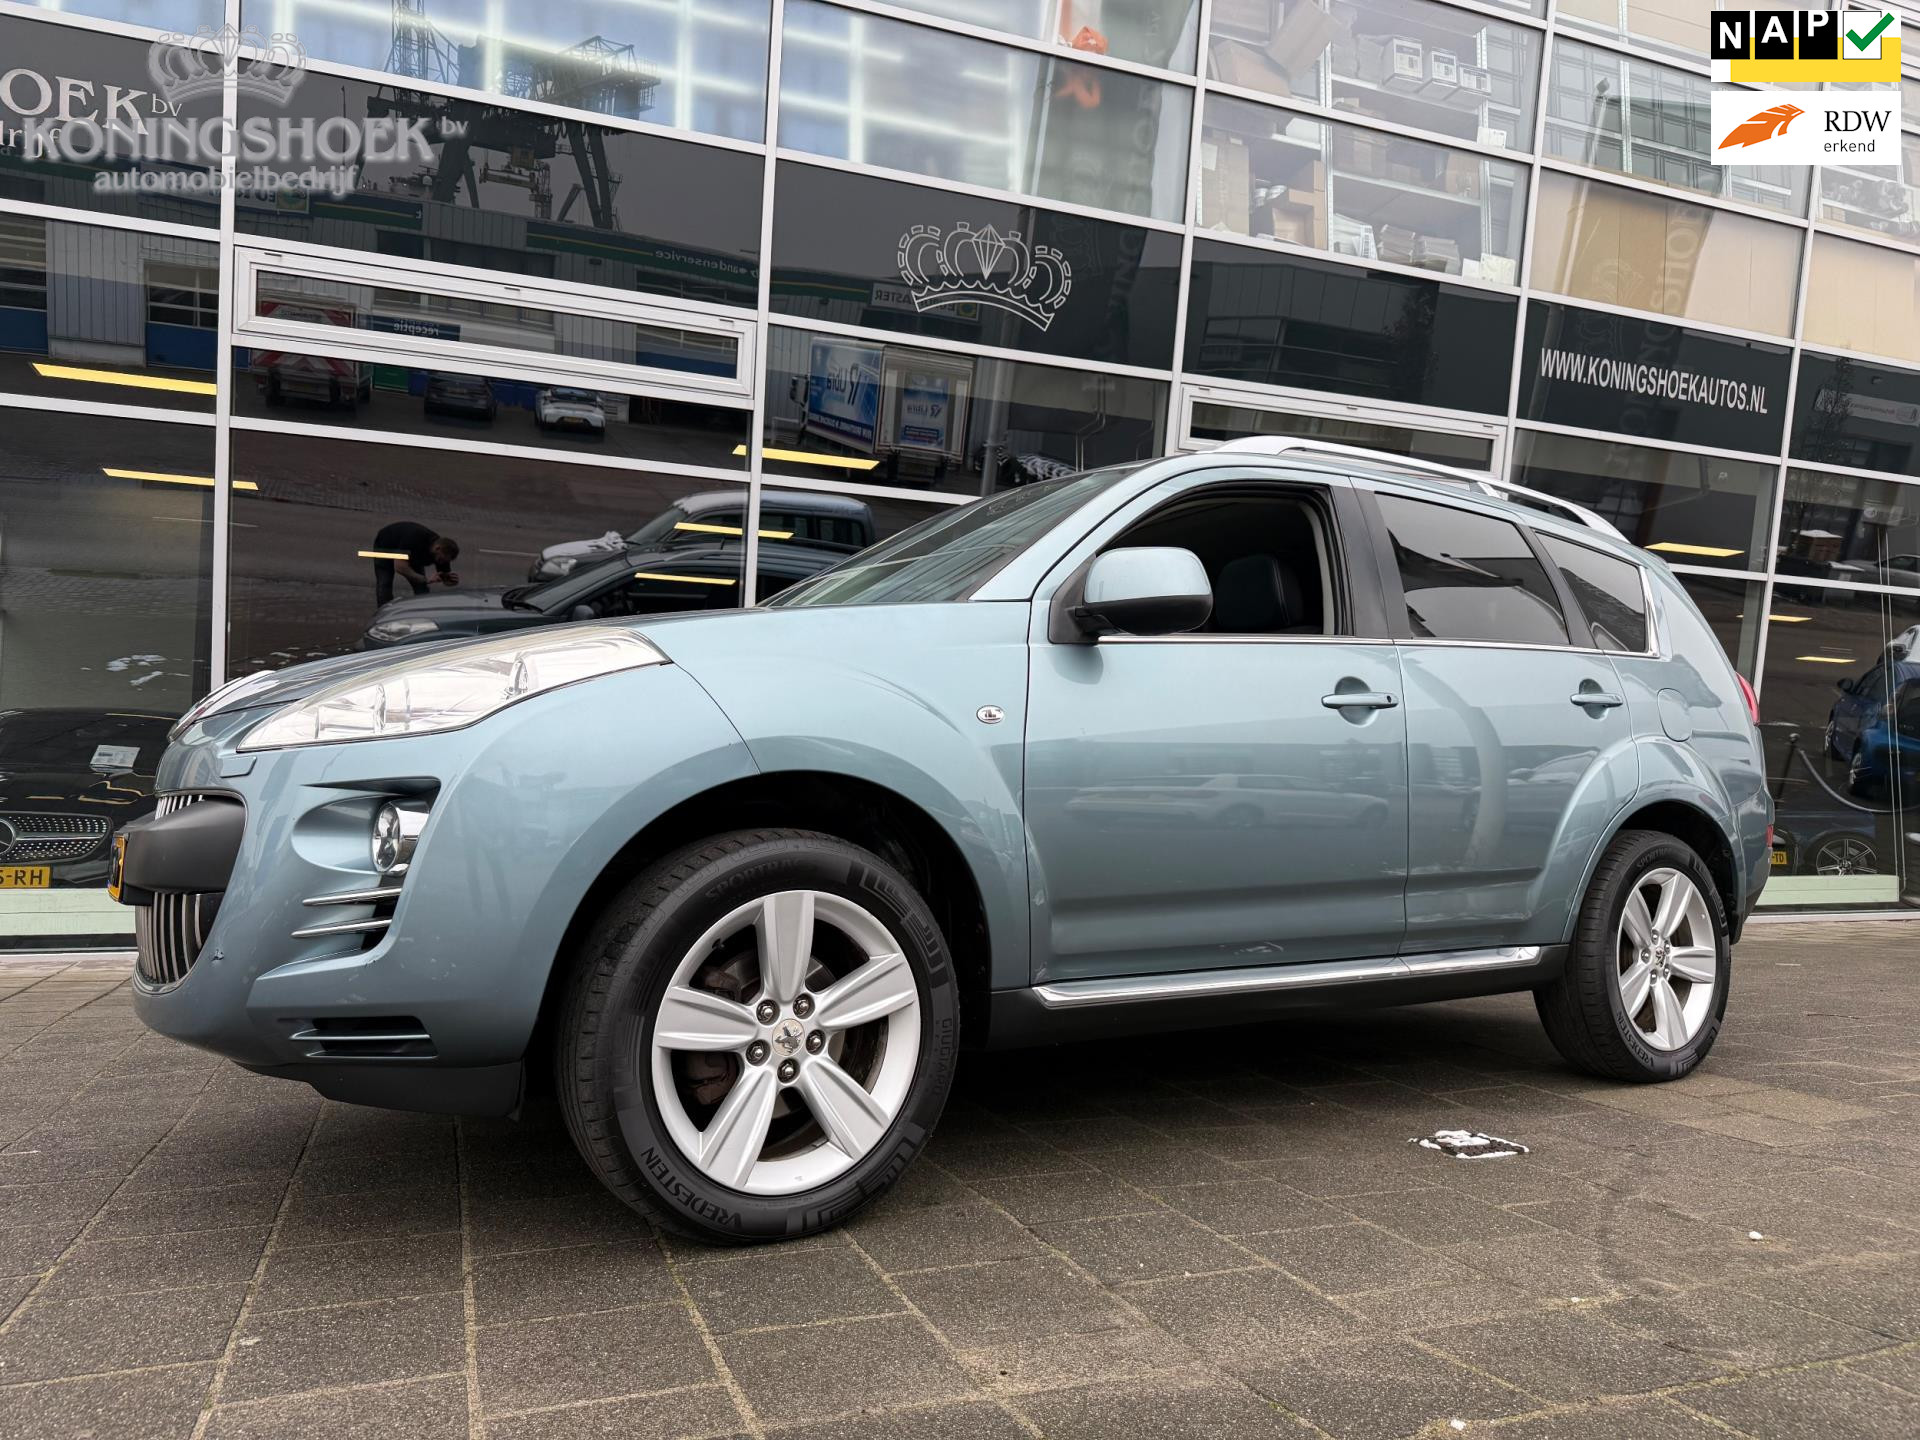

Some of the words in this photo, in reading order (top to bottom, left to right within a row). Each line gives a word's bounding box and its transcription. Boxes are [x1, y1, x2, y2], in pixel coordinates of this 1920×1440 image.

[151, 94, 182, 117] bv
[1541, 348, 1768, 414] WWW.KONINGSHOEKAUTOS.NL
[640, 1146, 743, 1230] VREDESTEIN
